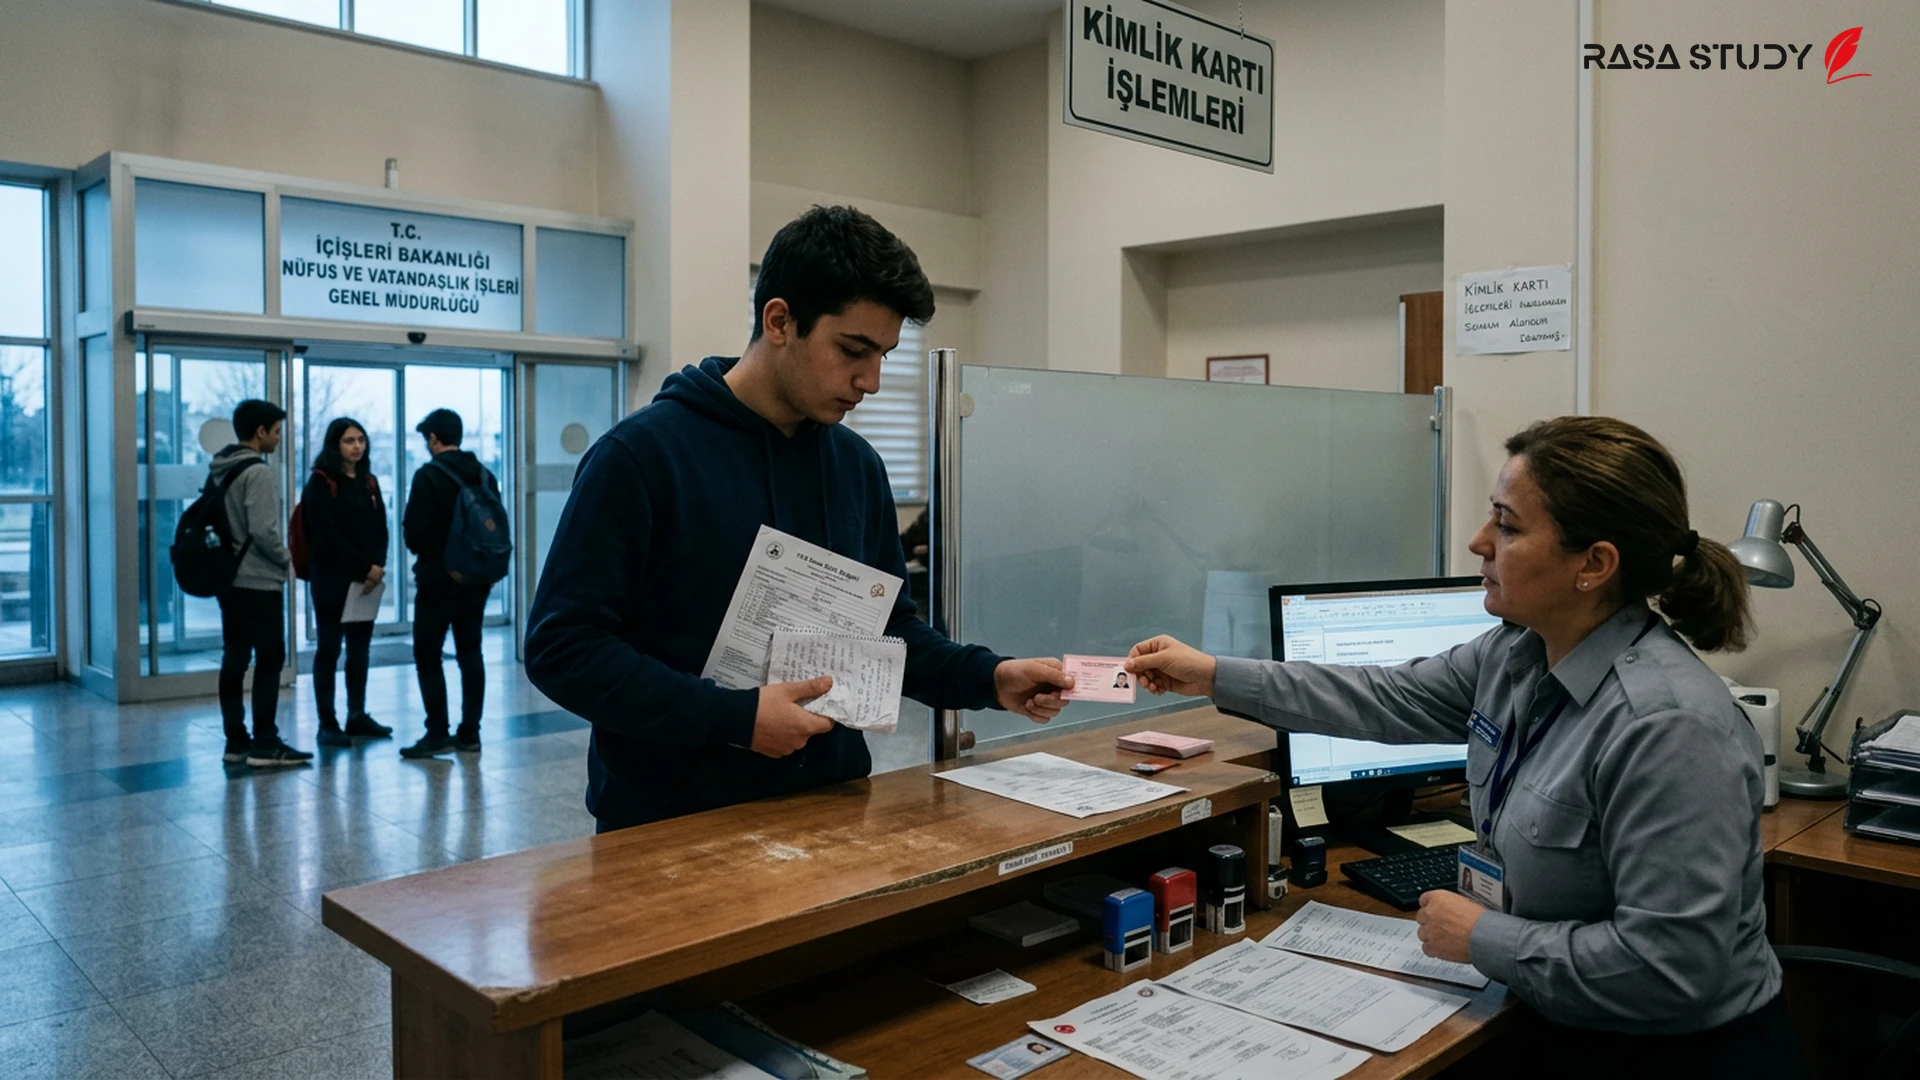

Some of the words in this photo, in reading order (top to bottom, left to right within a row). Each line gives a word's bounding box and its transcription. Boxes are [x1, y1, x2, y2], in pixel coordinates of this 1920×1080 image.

[1084, 5, 1183, 69] KİMLİK
[1191, 42, 1263, 95] KARTI
[1107, 57, 1244, 135] İŞLEMLERİ
[390, 222, 421, 240] T.C.
[316, 234, 392, 261] İÇİŞLERİ
[399, 247, 490, 270] BAKANLIĞI
[282, 257, 337, 280] NÜFUS
[342, 265, 363, 282] VE
[368, 268, 469, 291] VATANDAŞLIK
[474, 272, 519, 296] İŞLERİ
[1513, 279, 1549, 292] KARTI
[328, 288, 380, 307] GENEL
